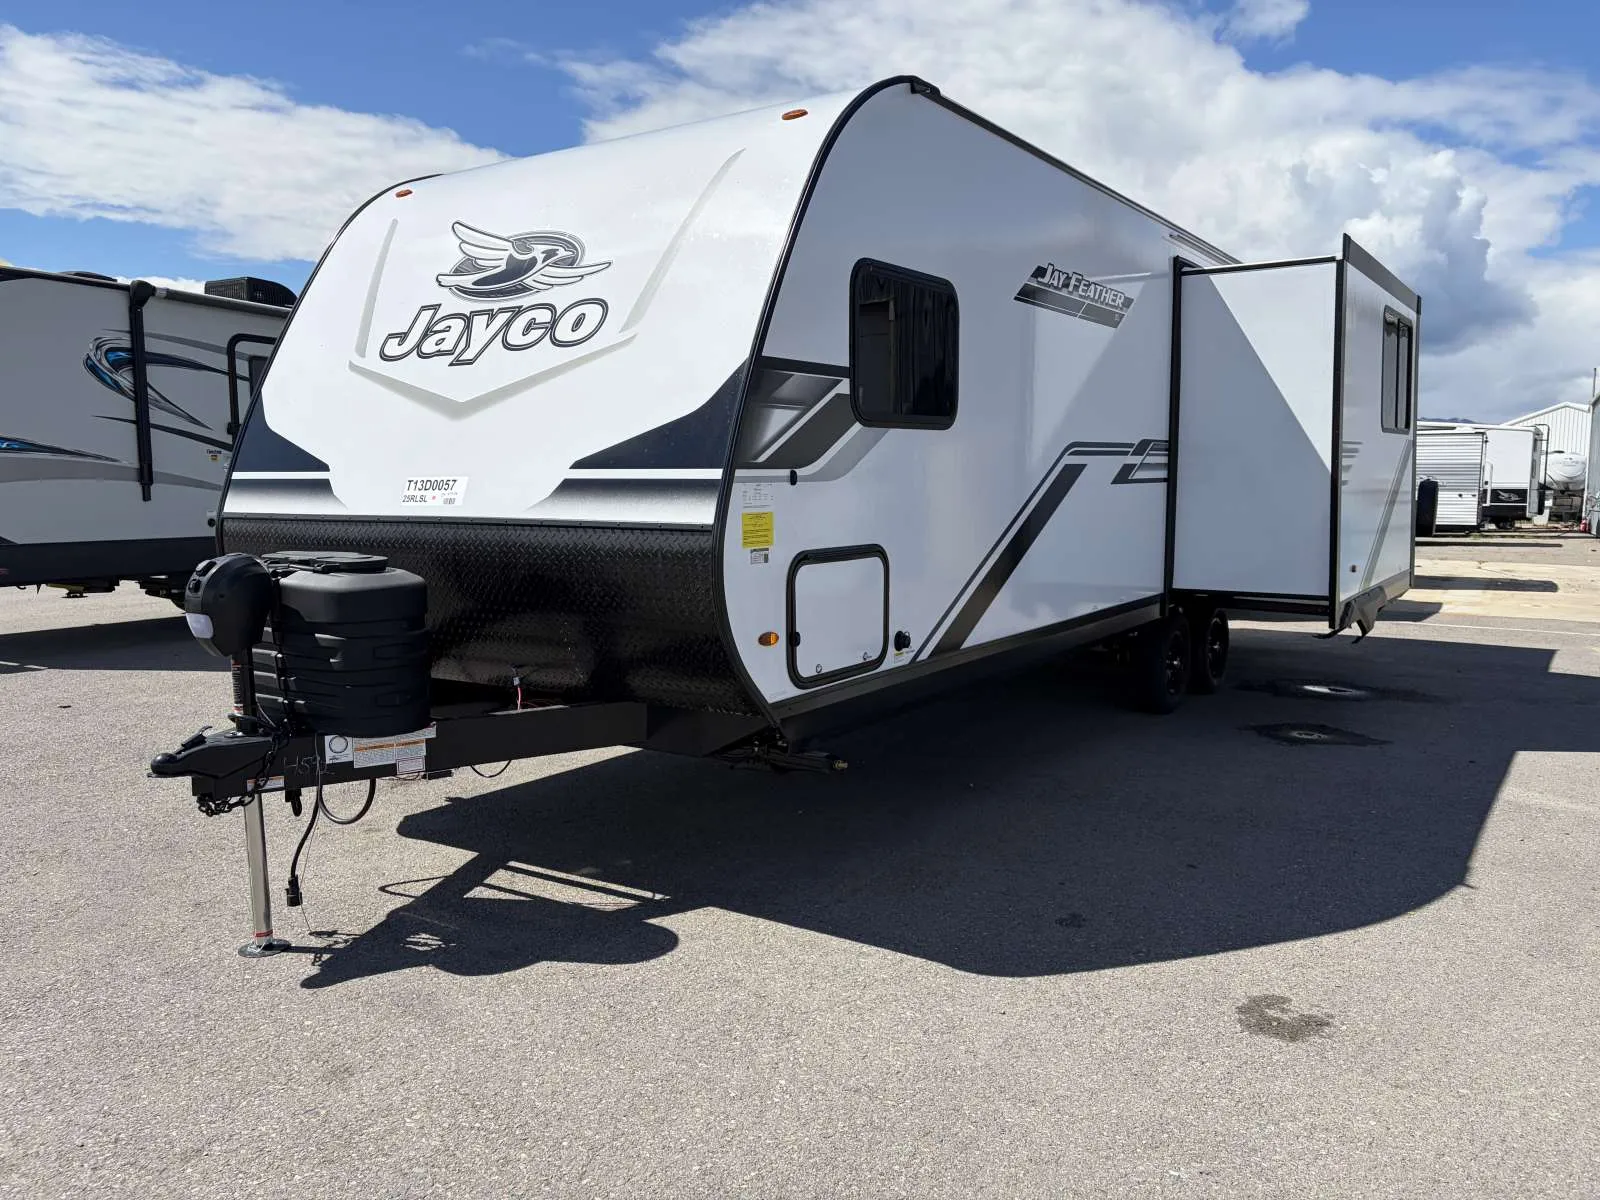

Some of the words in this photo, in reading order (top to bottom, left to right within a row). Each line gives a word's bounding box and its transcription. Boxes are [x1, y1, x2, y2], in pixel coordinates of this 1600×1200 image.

[1038, 262, 1069, 288] JAY
[1069, 271, 1126, 308] FEATHER
[379, 298, 608, 366] Jayco
[407, 479, 458, 491] T13D0057
